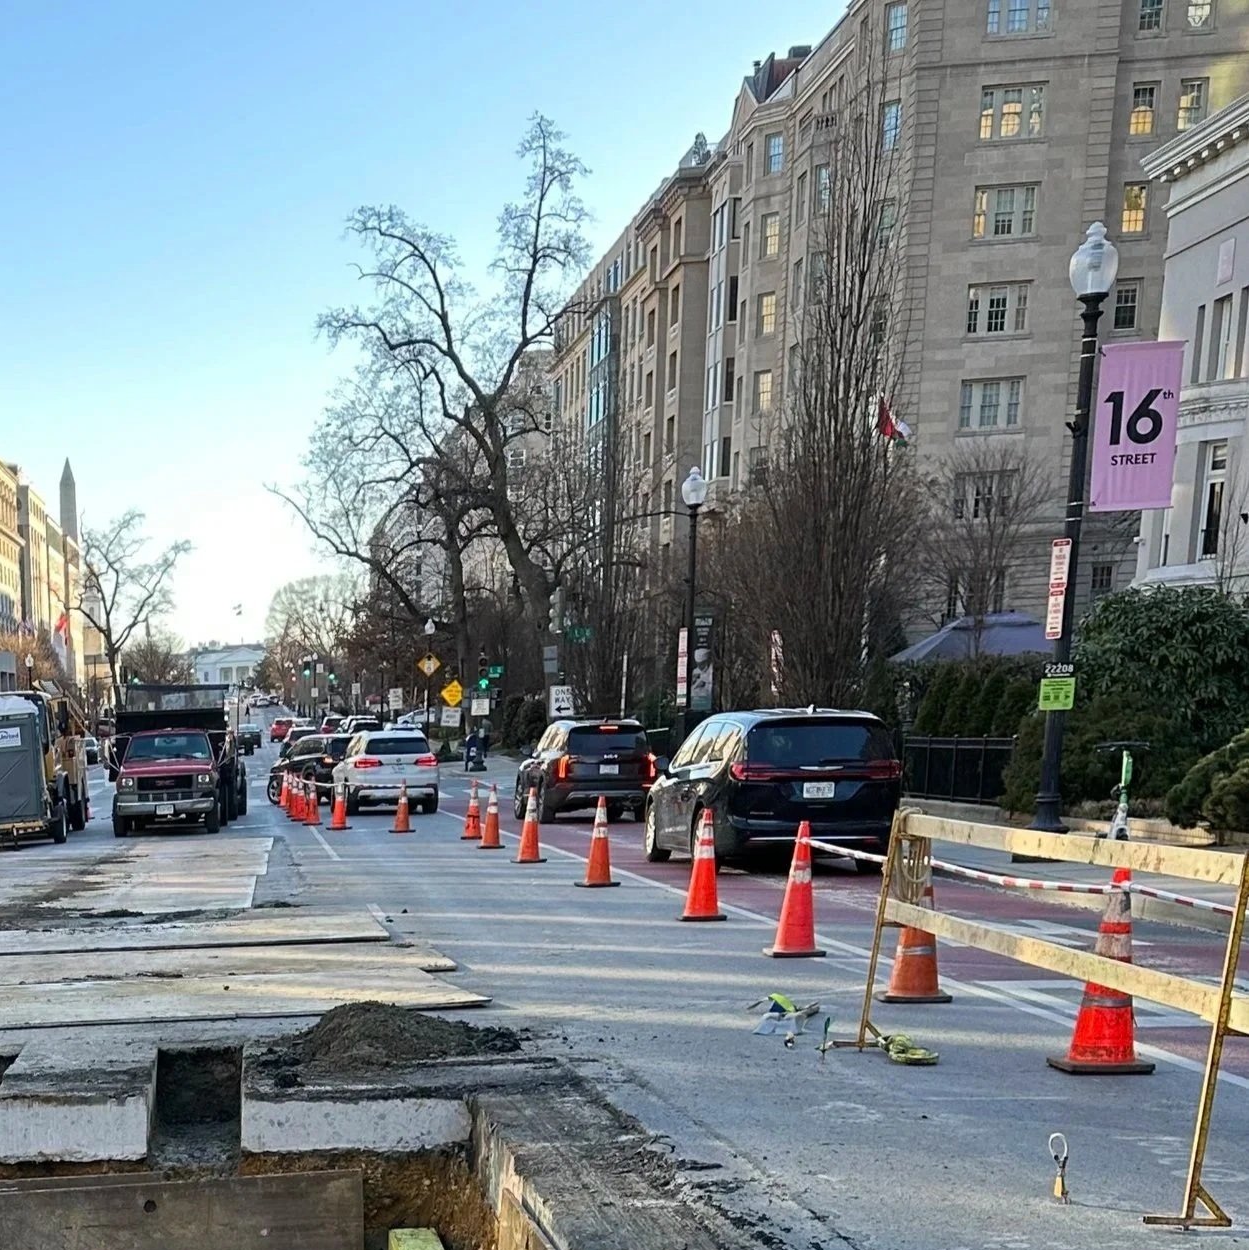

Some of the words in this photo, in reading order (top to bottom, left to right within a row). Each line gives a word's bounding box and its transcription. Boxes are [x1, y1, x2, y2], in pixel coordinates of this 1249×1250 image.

[1111, 452, 1157, 466] STREET
[555, 688, 571, 696] ONE
[555, 696, 571, 704] WAY
